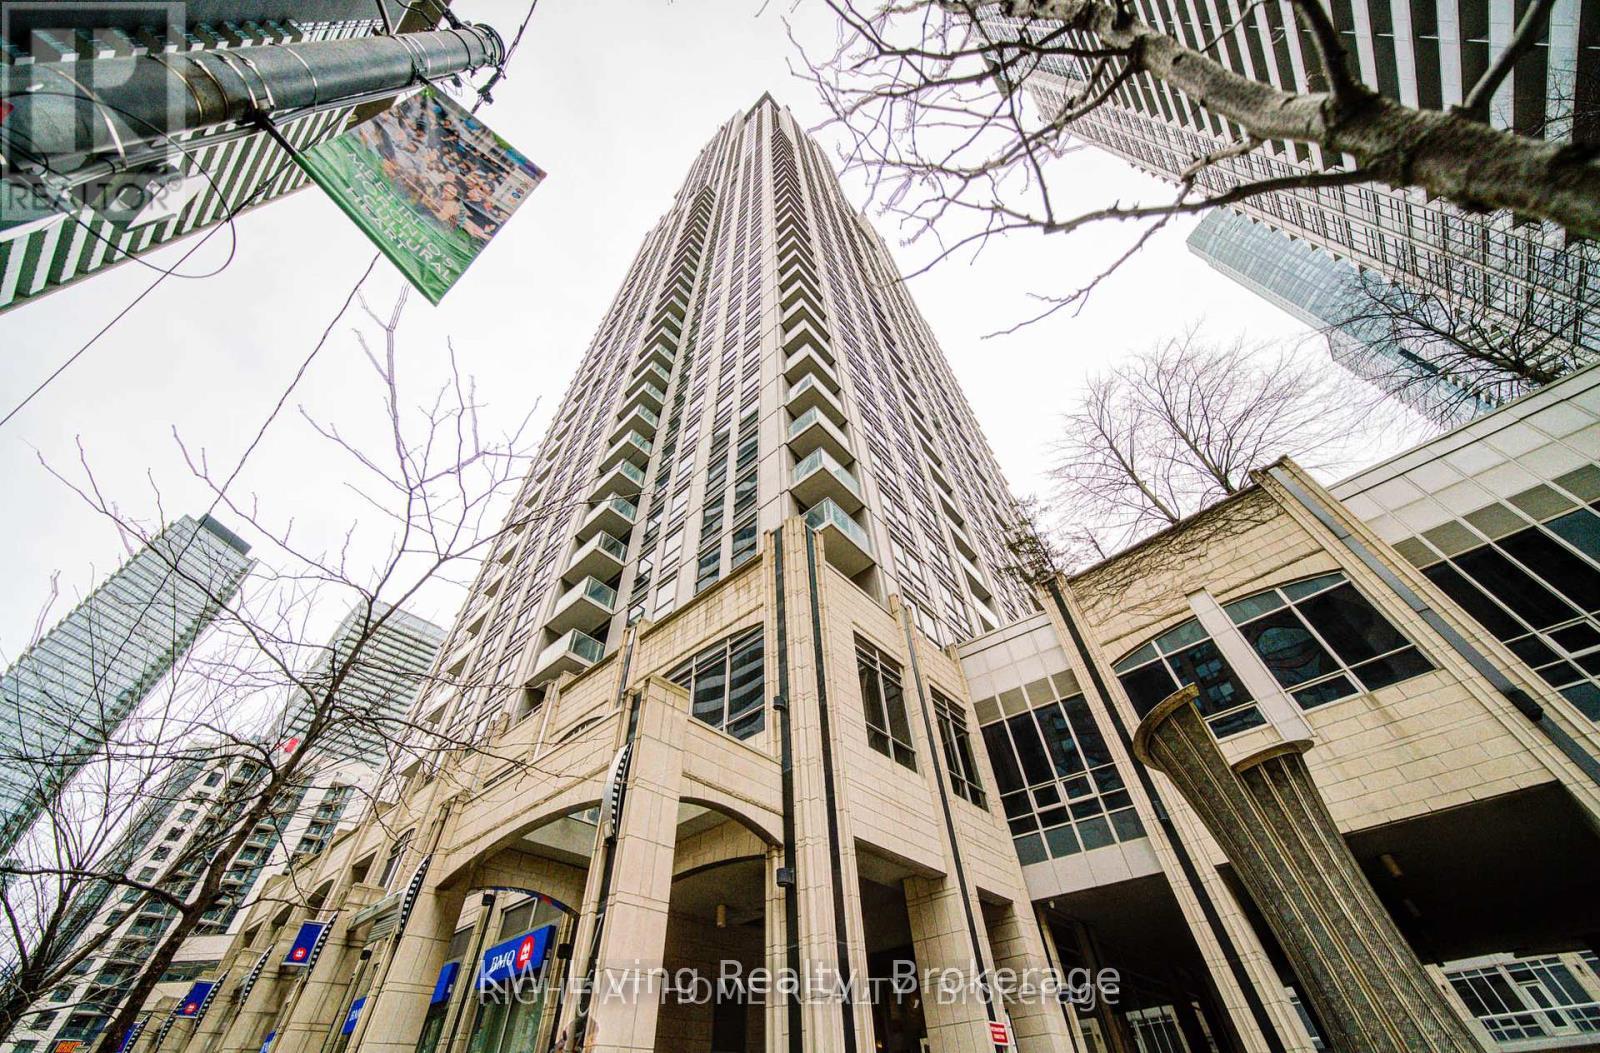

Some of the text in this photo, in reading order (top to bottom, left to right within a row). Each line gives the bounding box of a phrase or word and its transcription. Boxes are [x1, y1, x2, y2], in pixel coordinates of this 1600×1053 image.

[346, 187, 407, 249] HEART
[348, 153, 421, 225] MEET IN
[355, 172, 456, 268] TORONTO'S
[363, 194, 454, 279] CULTURAL
[490, 949, 516, 971] BMO
